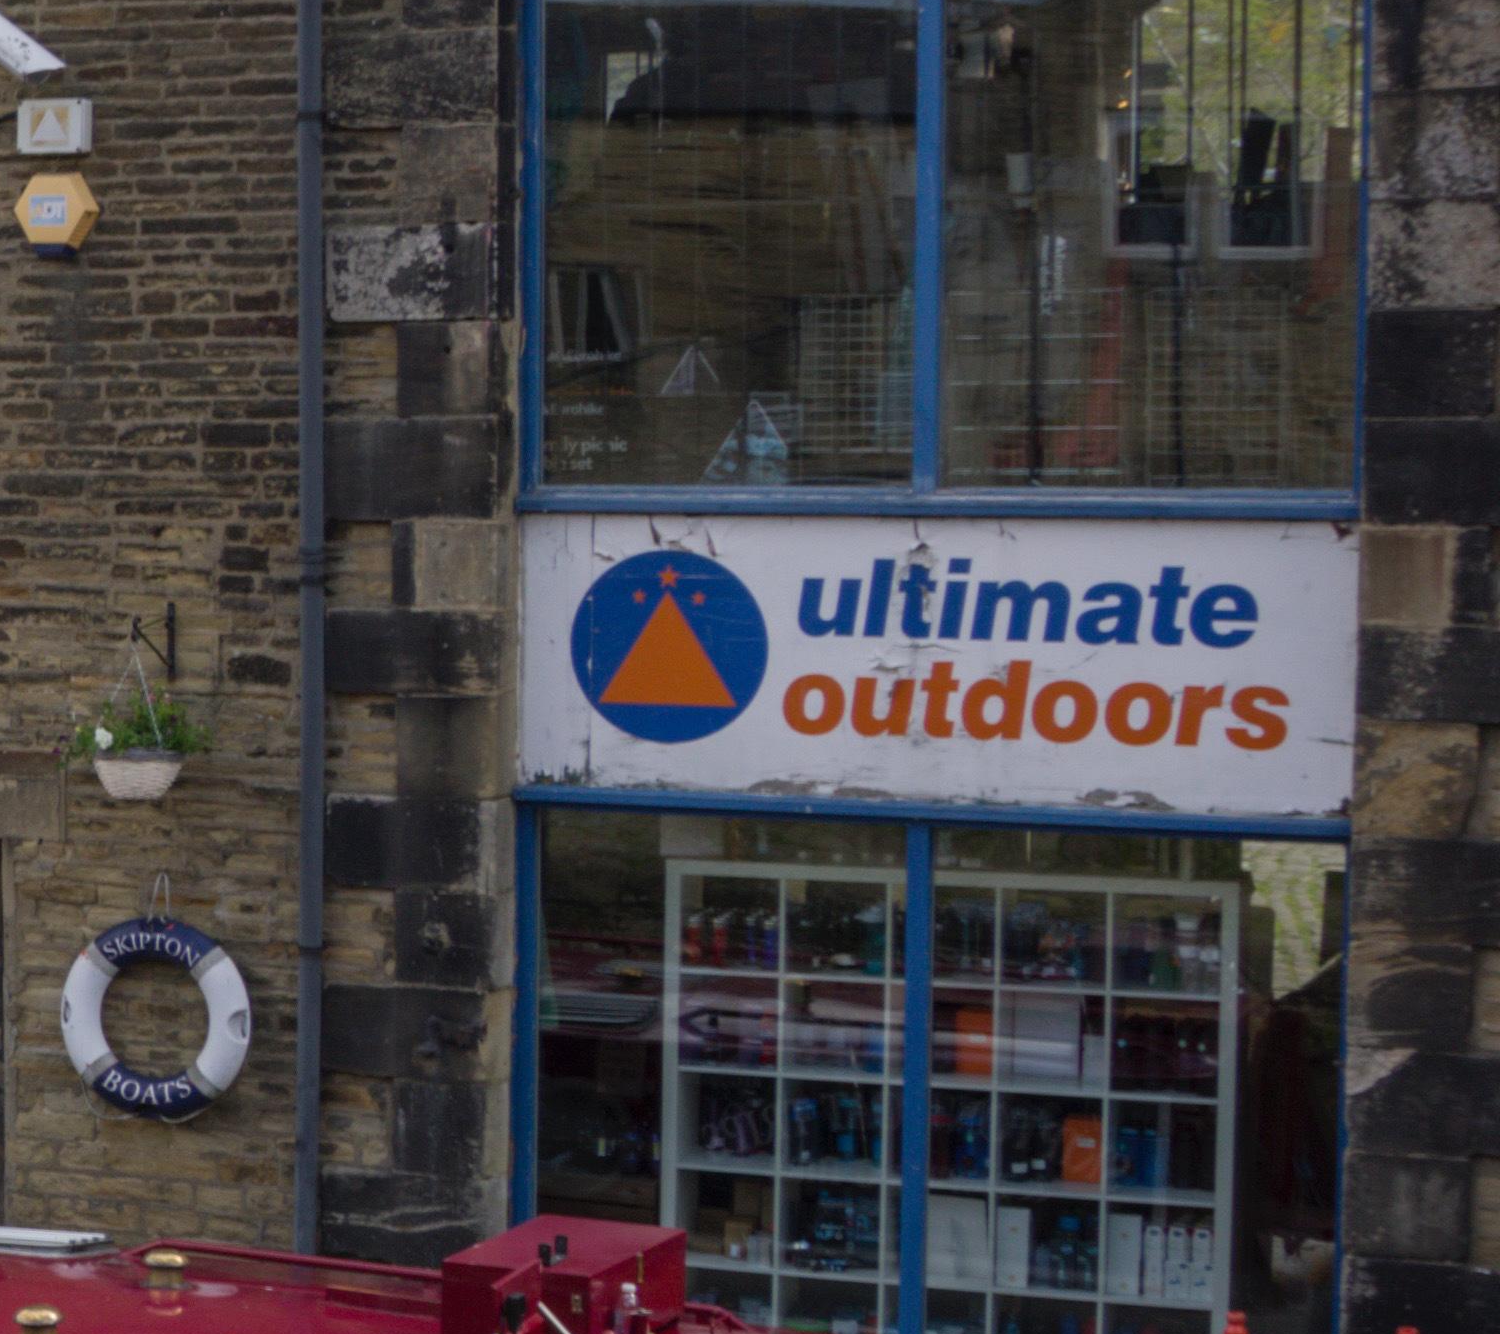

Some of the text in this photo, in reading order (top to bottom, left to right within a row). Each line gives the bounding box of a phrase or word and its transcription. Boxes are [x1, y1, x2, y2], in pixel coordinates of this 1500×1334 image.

[796, 558, 1259, 649] ultimate
[782, 659, 1290, 751] outdoors
[102, 932, 200, 967] SKIPTON
[102, 1069, 193, 1105] BOATS
